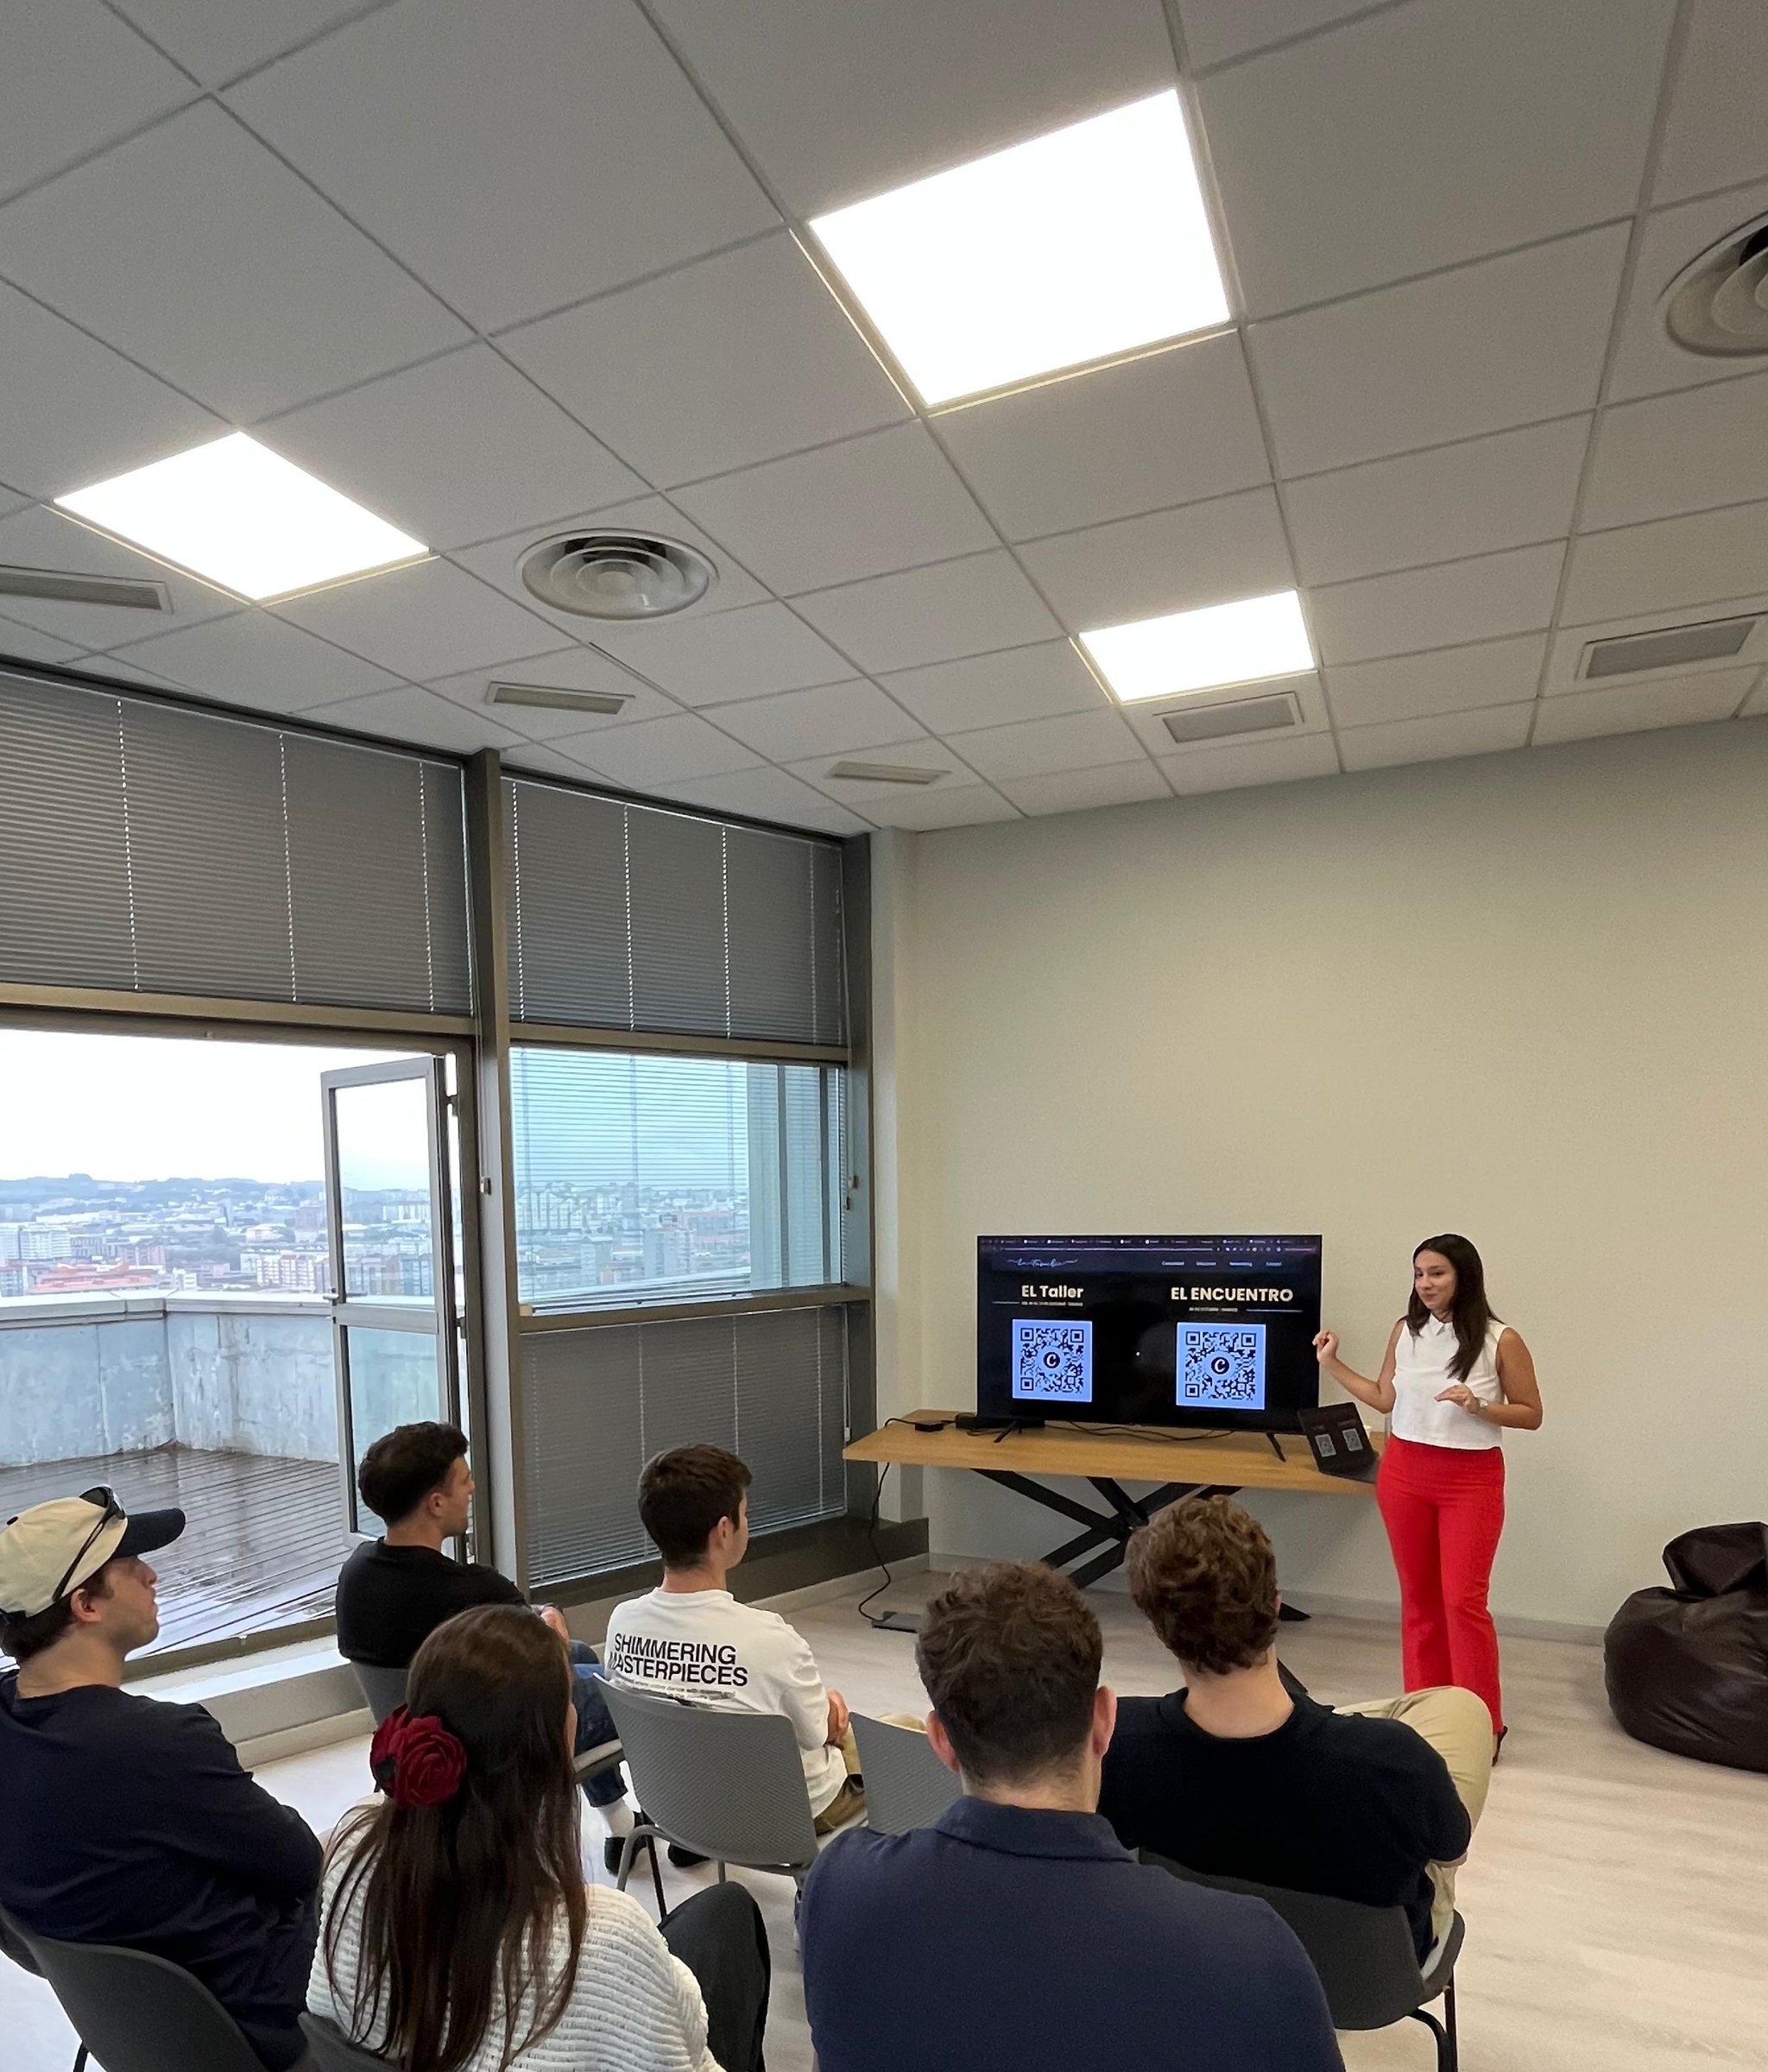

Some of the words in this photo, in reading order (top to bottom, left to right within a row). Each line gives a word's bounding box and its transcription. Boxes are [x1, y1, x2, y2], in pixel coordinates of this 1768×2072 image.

[1021, 1285, 1038, 1298] EL
[1039, 1285, 1084, 1298] Taller
[1171, 1287, 1188, 1300] EL
[1190, 1287, 1293, 1302] ENCUENTRO
[615, 1633, 736, 1665] SHIMMERING
[607, 1652, 748, 1687] MASTERPIECES
